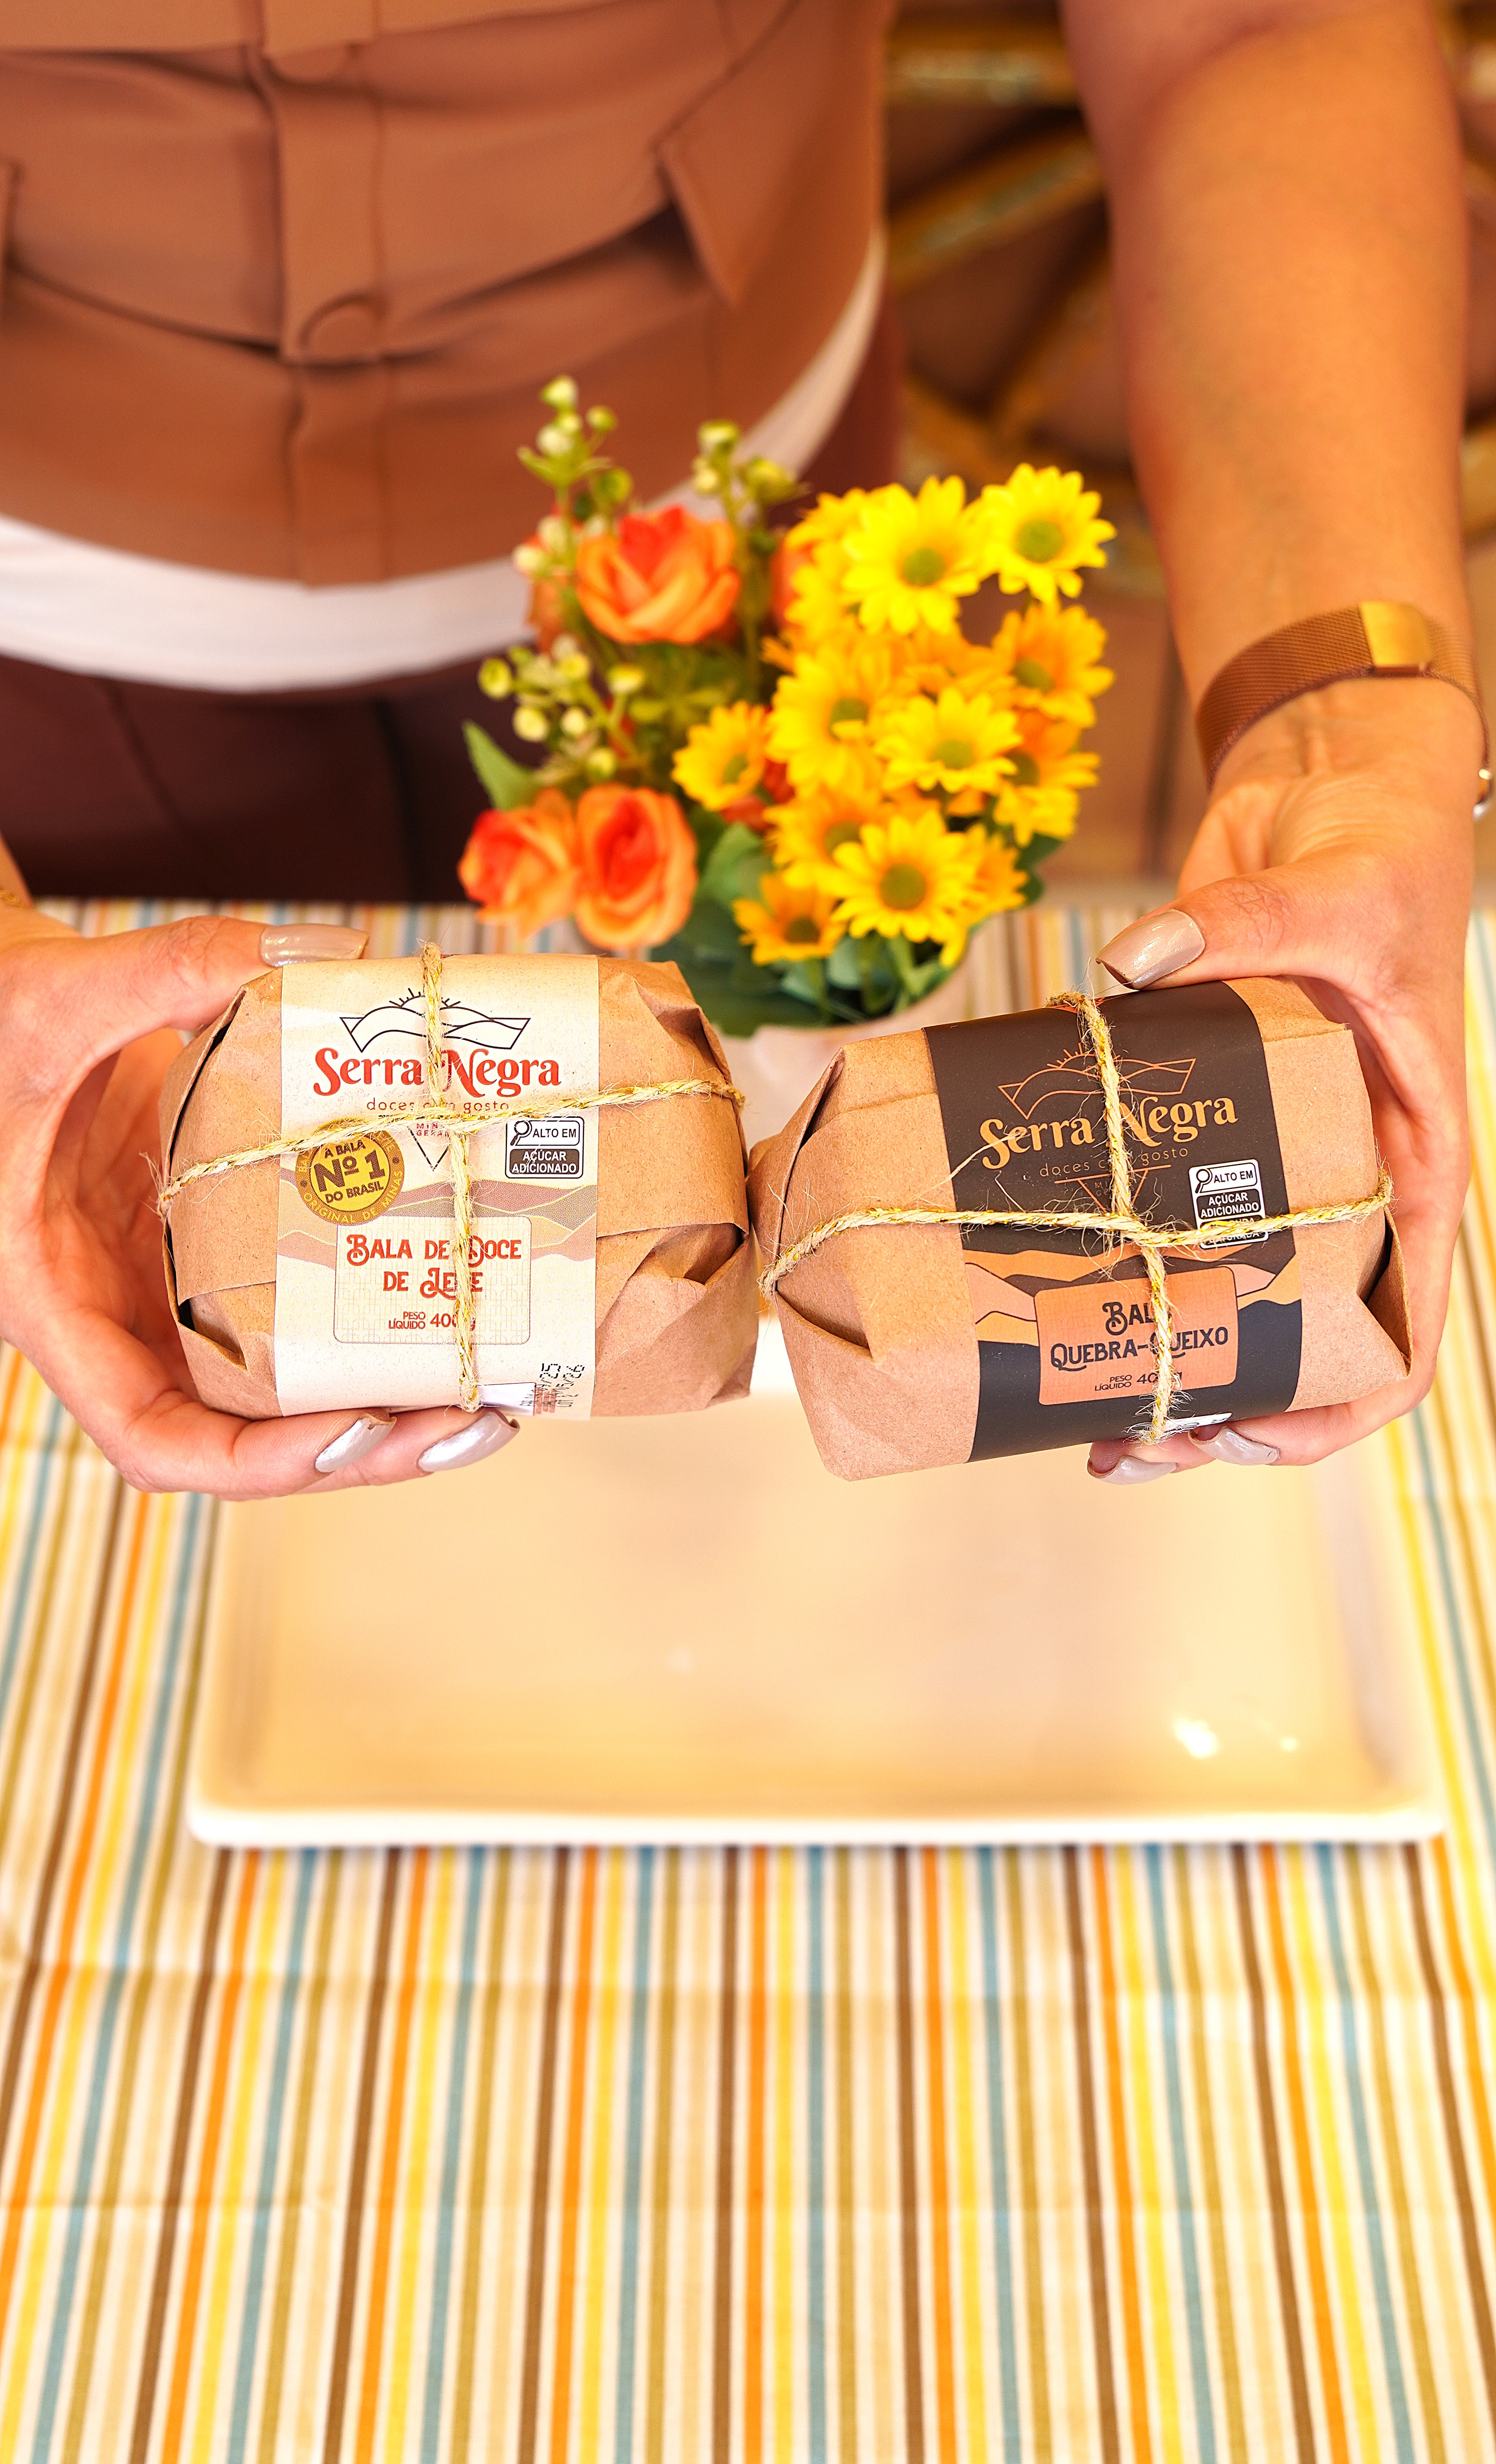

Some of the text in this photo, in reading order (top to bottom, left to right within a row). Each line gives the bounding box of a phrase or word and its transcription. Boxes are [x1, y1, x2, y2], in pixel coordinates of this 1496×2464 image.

[313, 1047, 561, 1097] Serra Negra
[366, 1097, 415, 1111] doces
[464, 1101, 509, 1114] gosto
[533, 1129, 576, 1137] ALTO EM
[979, 1096, 1238, 1169] Serra Negra
[324, 1148, 334, 1158] A
[335, 1140, 366, 1155] BALA
[522, 1149, 566, 1163] AÇÚCAR
[365, 1149, 385, 1180] 1
[511, 1163, 577, 1173] ADICIONADO
[1040, 1161, 1090, 1177] doces
[1141, 1147, 1188, 1167] gosto
[1214, 1170, 1253, 1183] ALTO EM
[304, 1171, 403, 1223] ORIGINAL DE MINAS
[325, 1181, 384, 1203] DO BRASIL
[1208, 1192, 1248, 1207] AÇÚCAR
[1200, 1202, 1259, 1218] ADICIONADO
[346, 1234, 413, 1266] BALA
[424, 1240, 450, 1260] DE
[383, 1271, 409, 1291] DE
[388, 1318, 426, 1329] LÍQUIDO
[403, 1311, 426, 1320] PESO
[1103, 1301, 1157, 1335] BAL
[1095, 1382, 1132, 1391] LÍQUIDO
[1110, 1375, 1132, 1383] PESO
